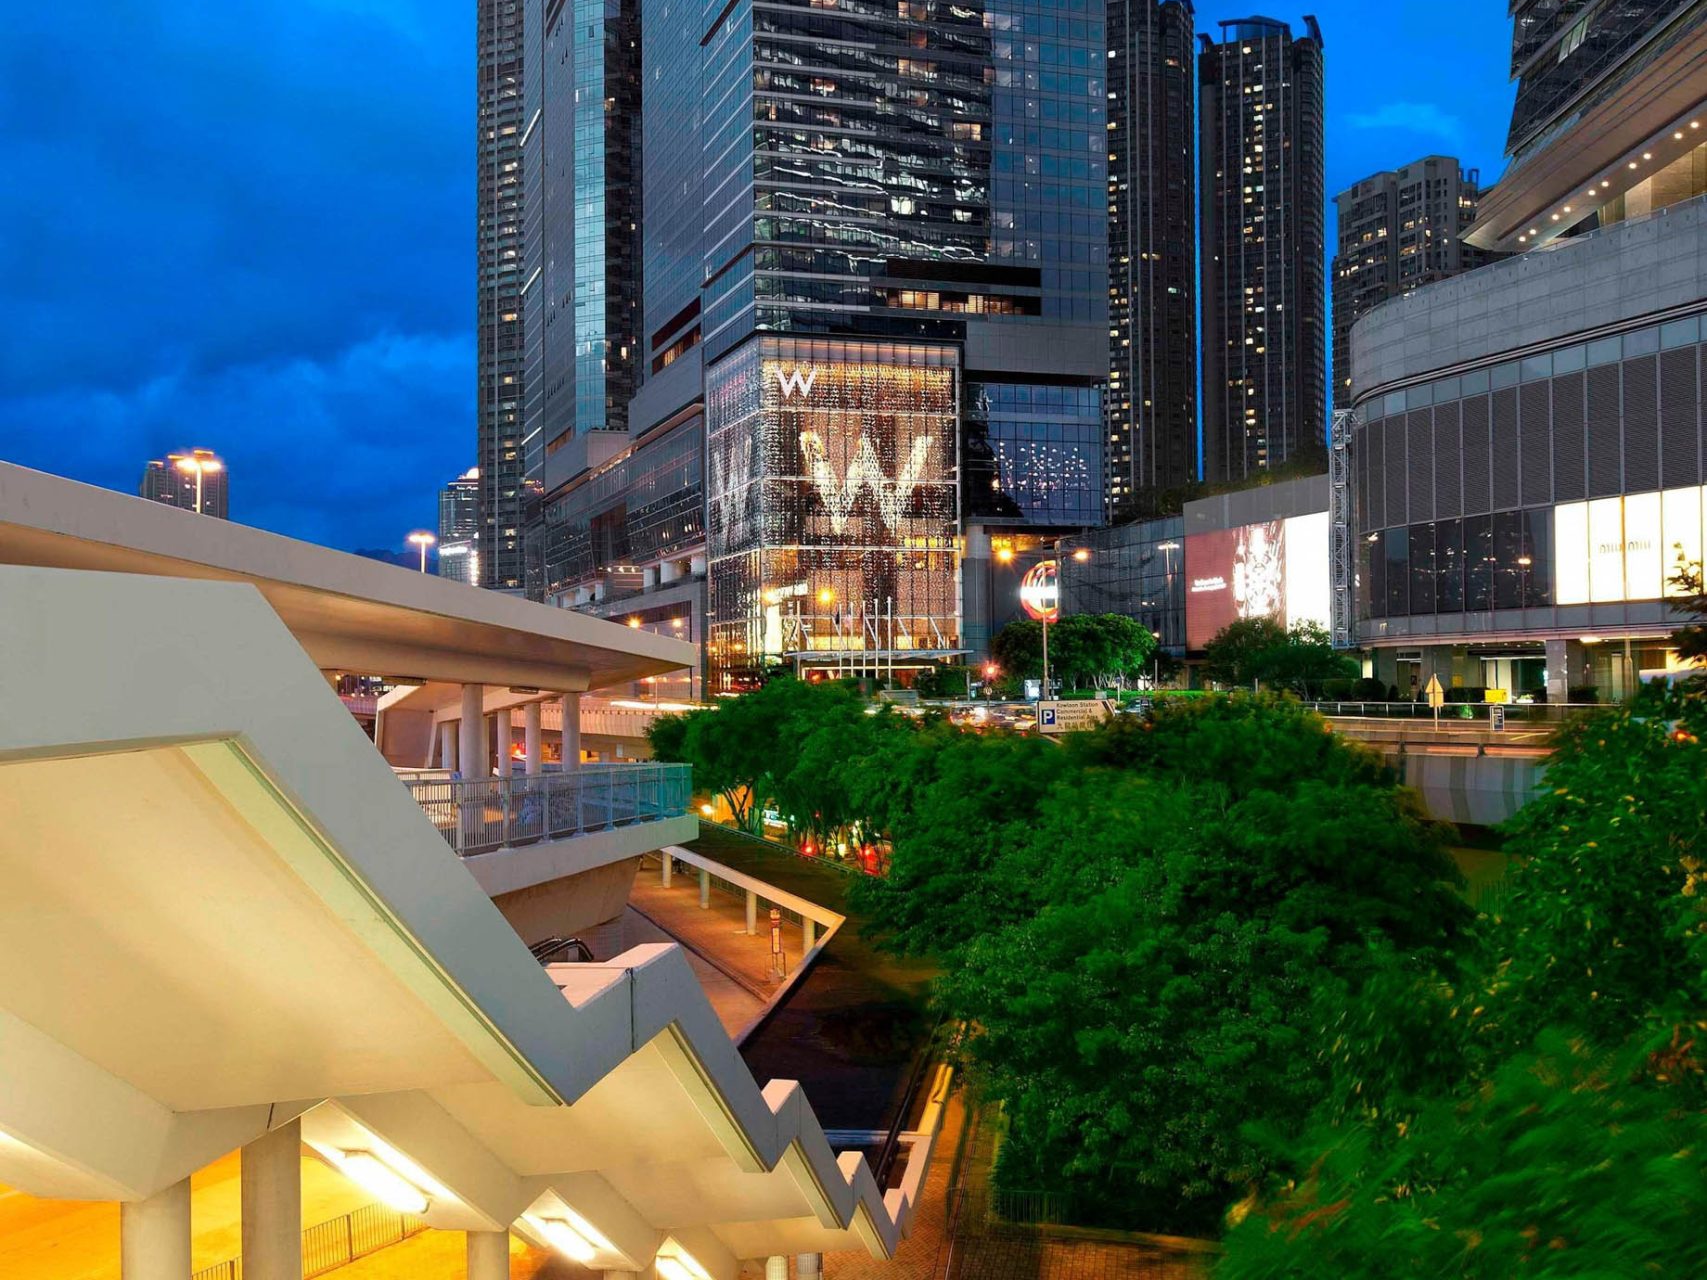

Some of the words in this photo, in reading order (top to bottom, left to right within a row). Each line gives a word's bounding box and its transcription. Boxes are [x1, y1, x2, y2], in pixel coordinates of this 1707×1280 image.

[775, 367, 817, 399] W
[799, 430, 933, 538] W
[1043, 710, 1053, 724] P
